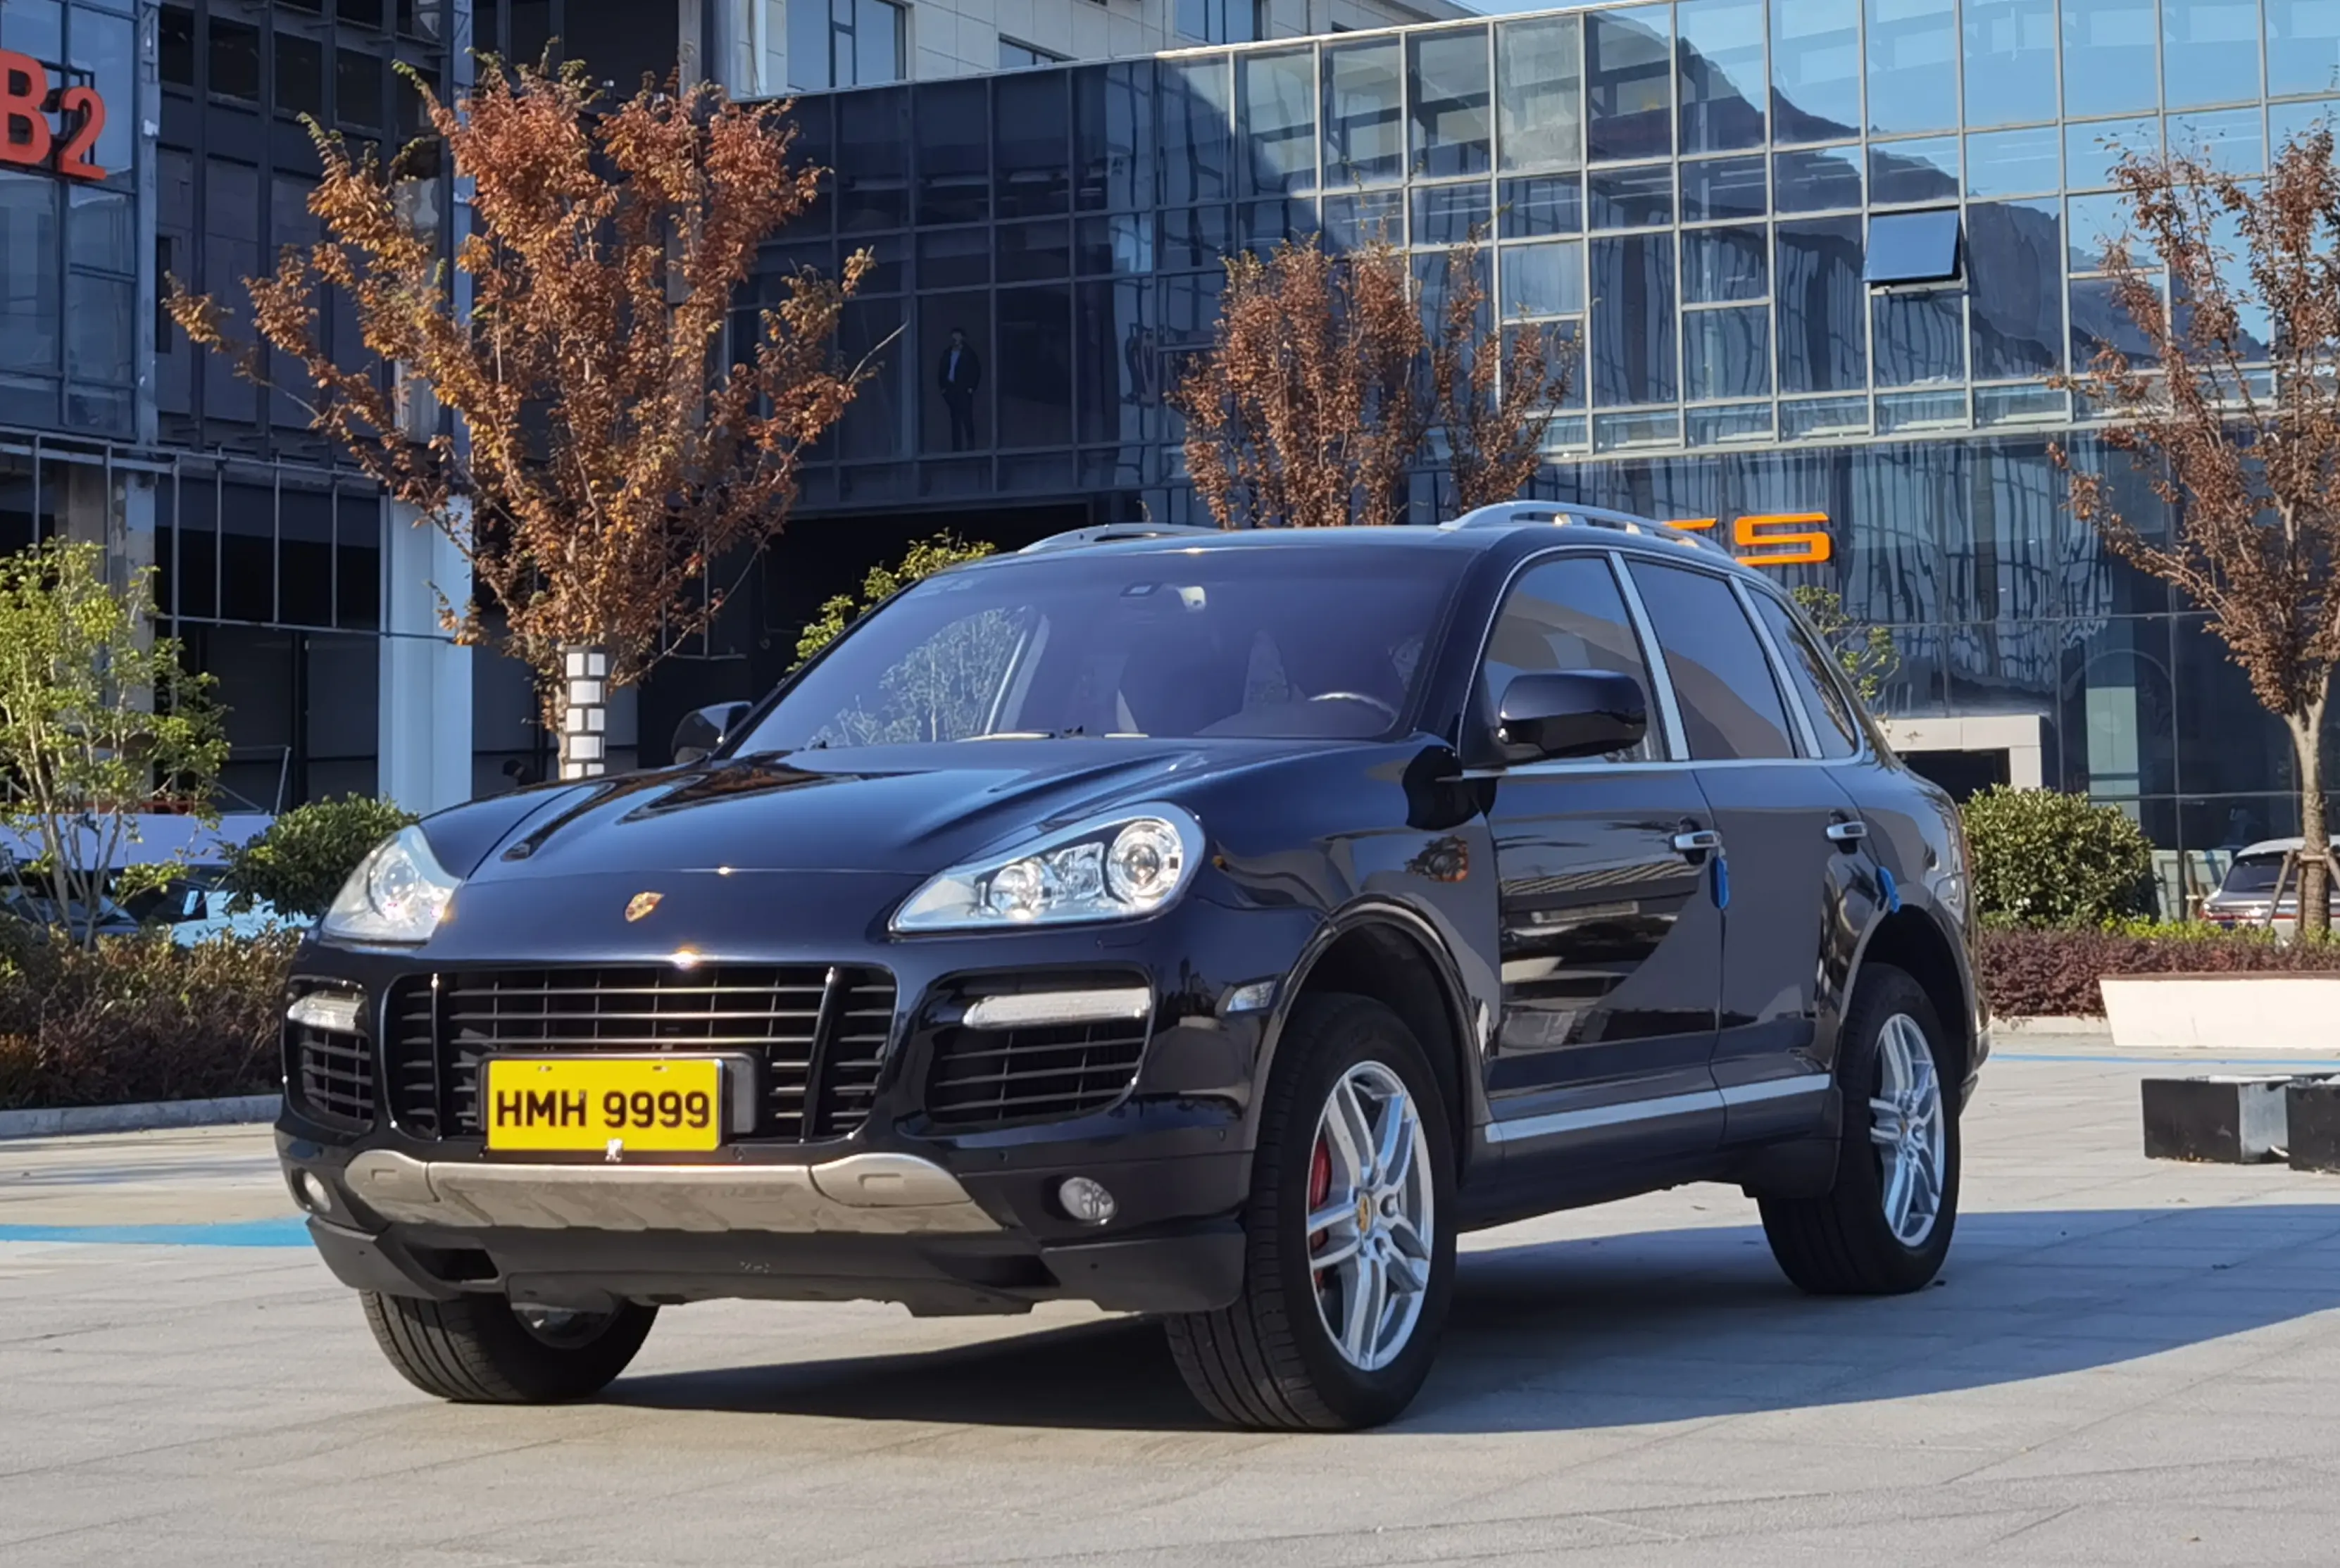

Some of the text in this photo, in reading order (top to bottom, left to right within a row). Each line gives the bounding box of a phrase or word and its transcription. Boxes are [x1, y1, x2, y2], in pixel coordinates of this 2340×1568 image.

[0, 49, 107, 181] B2
[1662, 512, 1831, 566] S
[496, 1090, 710, 1129] HMH 9999
